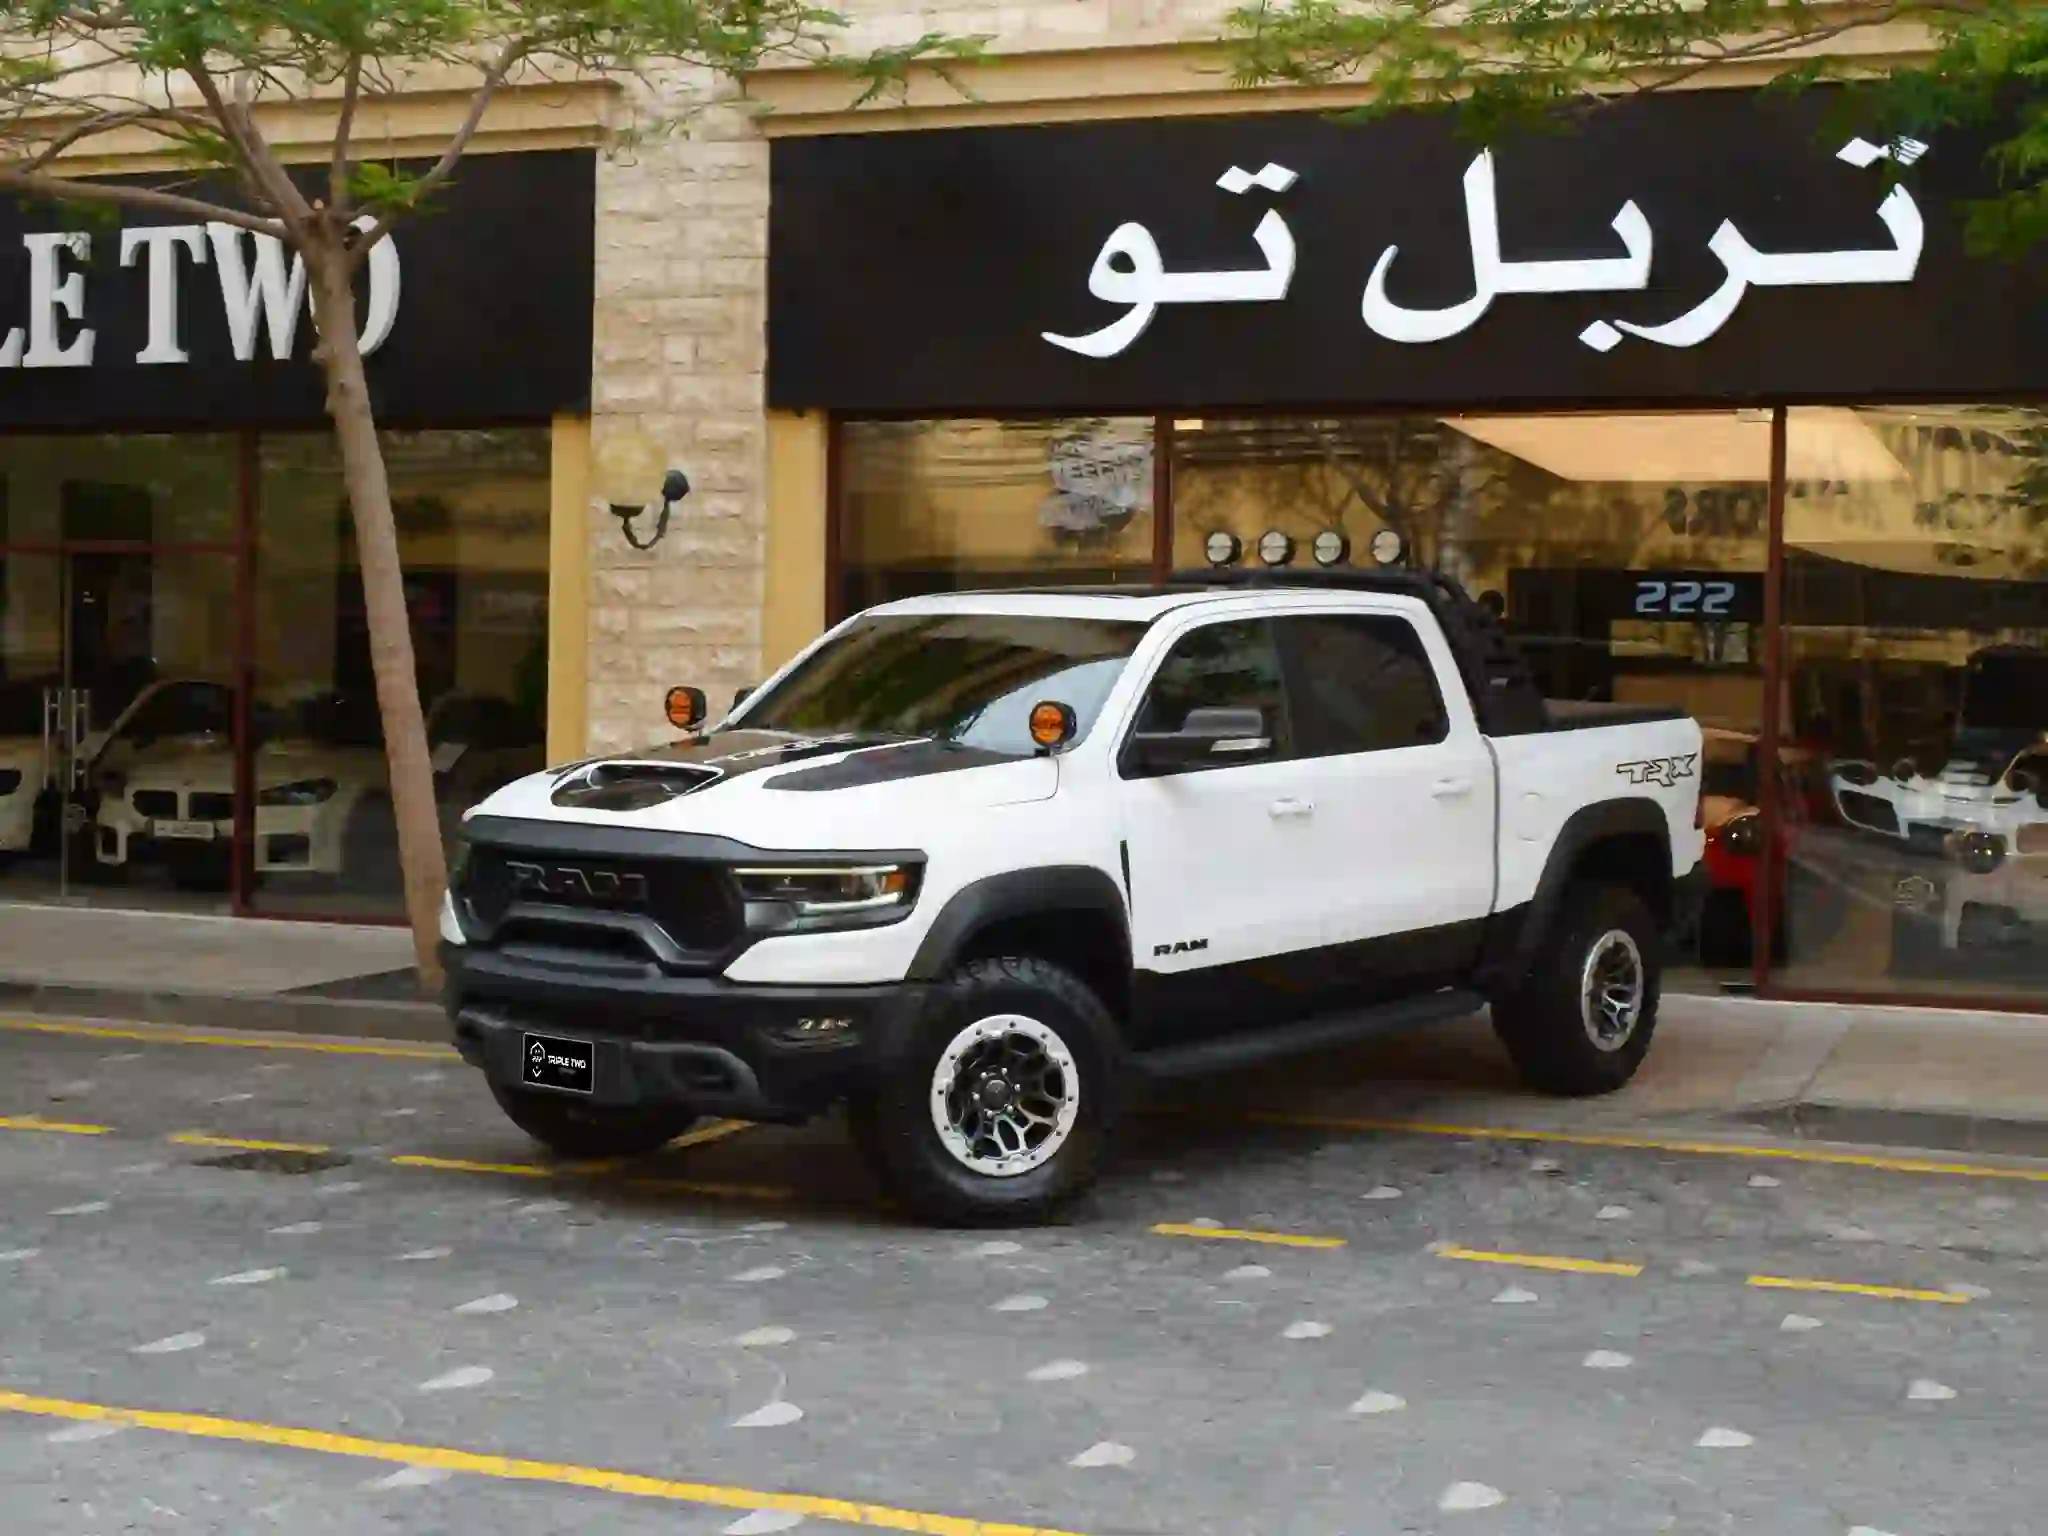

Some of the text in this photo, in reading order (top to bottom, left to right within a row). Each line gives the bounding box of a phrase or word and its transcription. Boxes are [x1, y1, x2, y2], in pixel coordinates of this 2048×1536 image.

[1041, 161, 1300, 358] تو
[1635, 581, 1736, 613] 222
[1616, 752, 1698, 787] TRX
[1153, 938, 1209, 957] RAM
[571, 1058, 586, 1068] TWO
